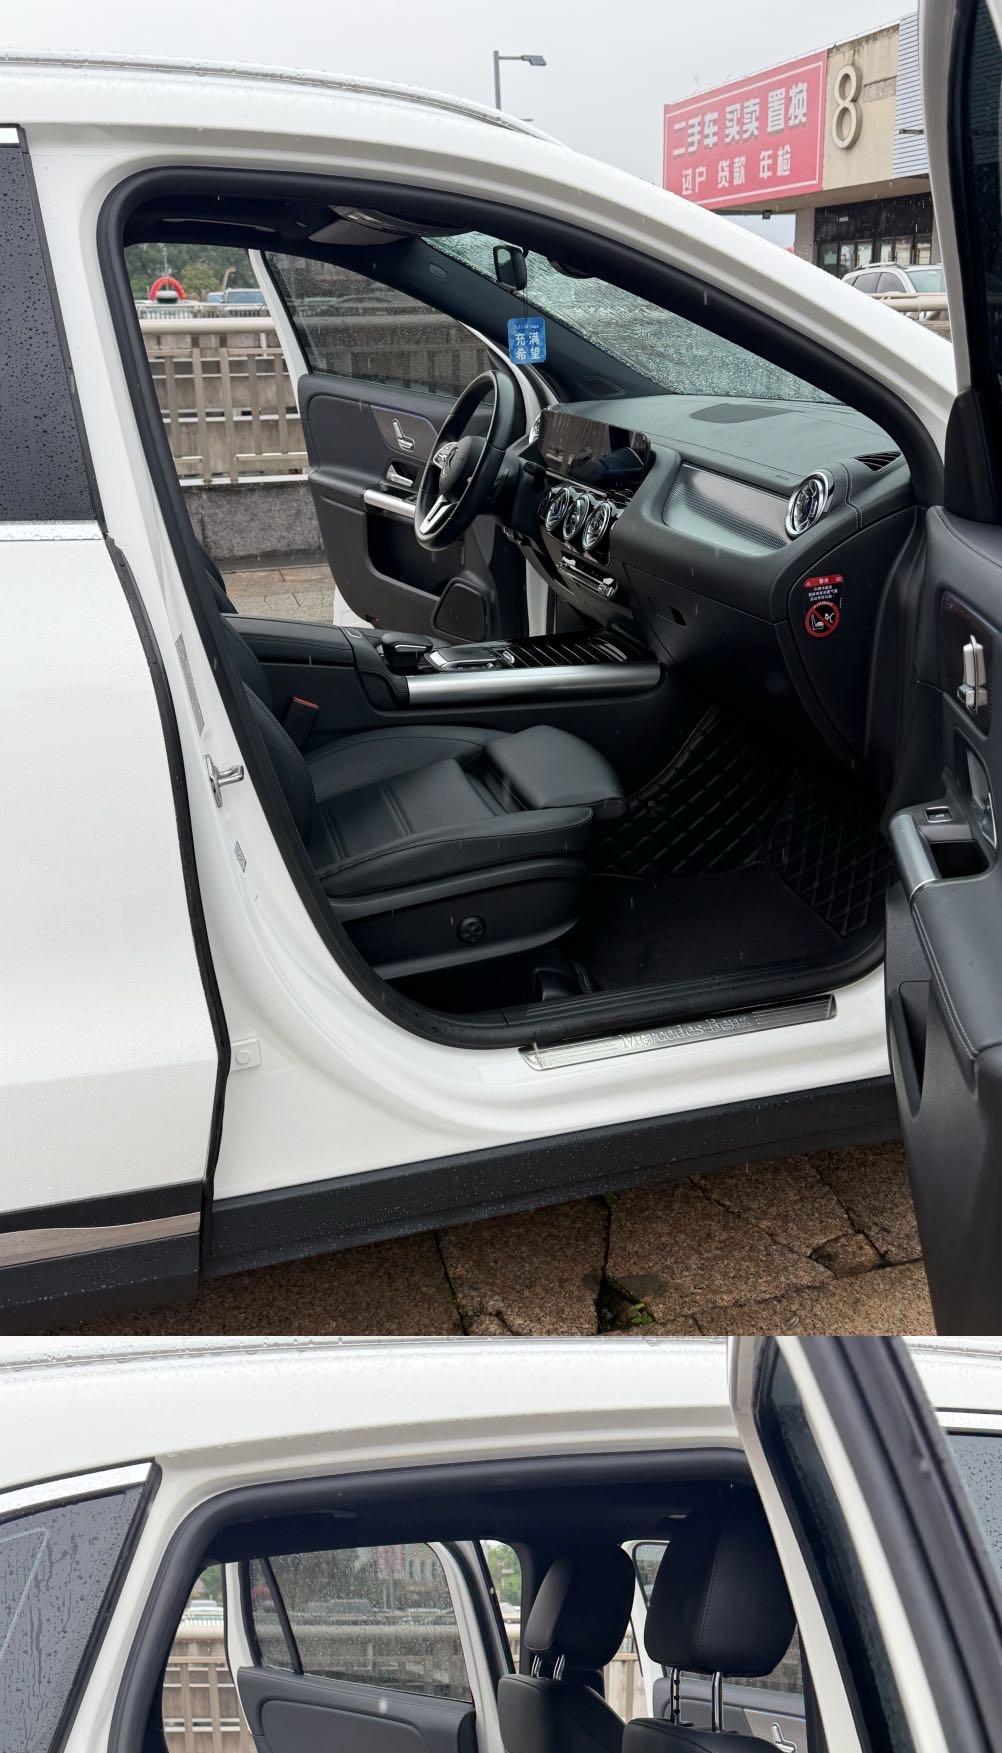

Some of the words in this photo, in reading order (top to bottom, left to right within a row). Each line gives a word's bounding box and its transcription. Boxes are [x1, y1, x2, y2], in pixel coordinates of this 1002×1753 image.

[672, 111, 719, 157] 二手车
[724, 98, 760, 144] 买卖
[767, 82, 808, 134] 置换
[831, 64, 863, 149] 8
[681, 166, 707, 195] 过户
[717, 156, 747, 188] 贷款
[759, 145, 792, 180] 年检
[515, 331, 540, 346] 充满
[515, 346, 542, 361] 希望
[619, 1015, 749, 1048] Mercedes-Benz
